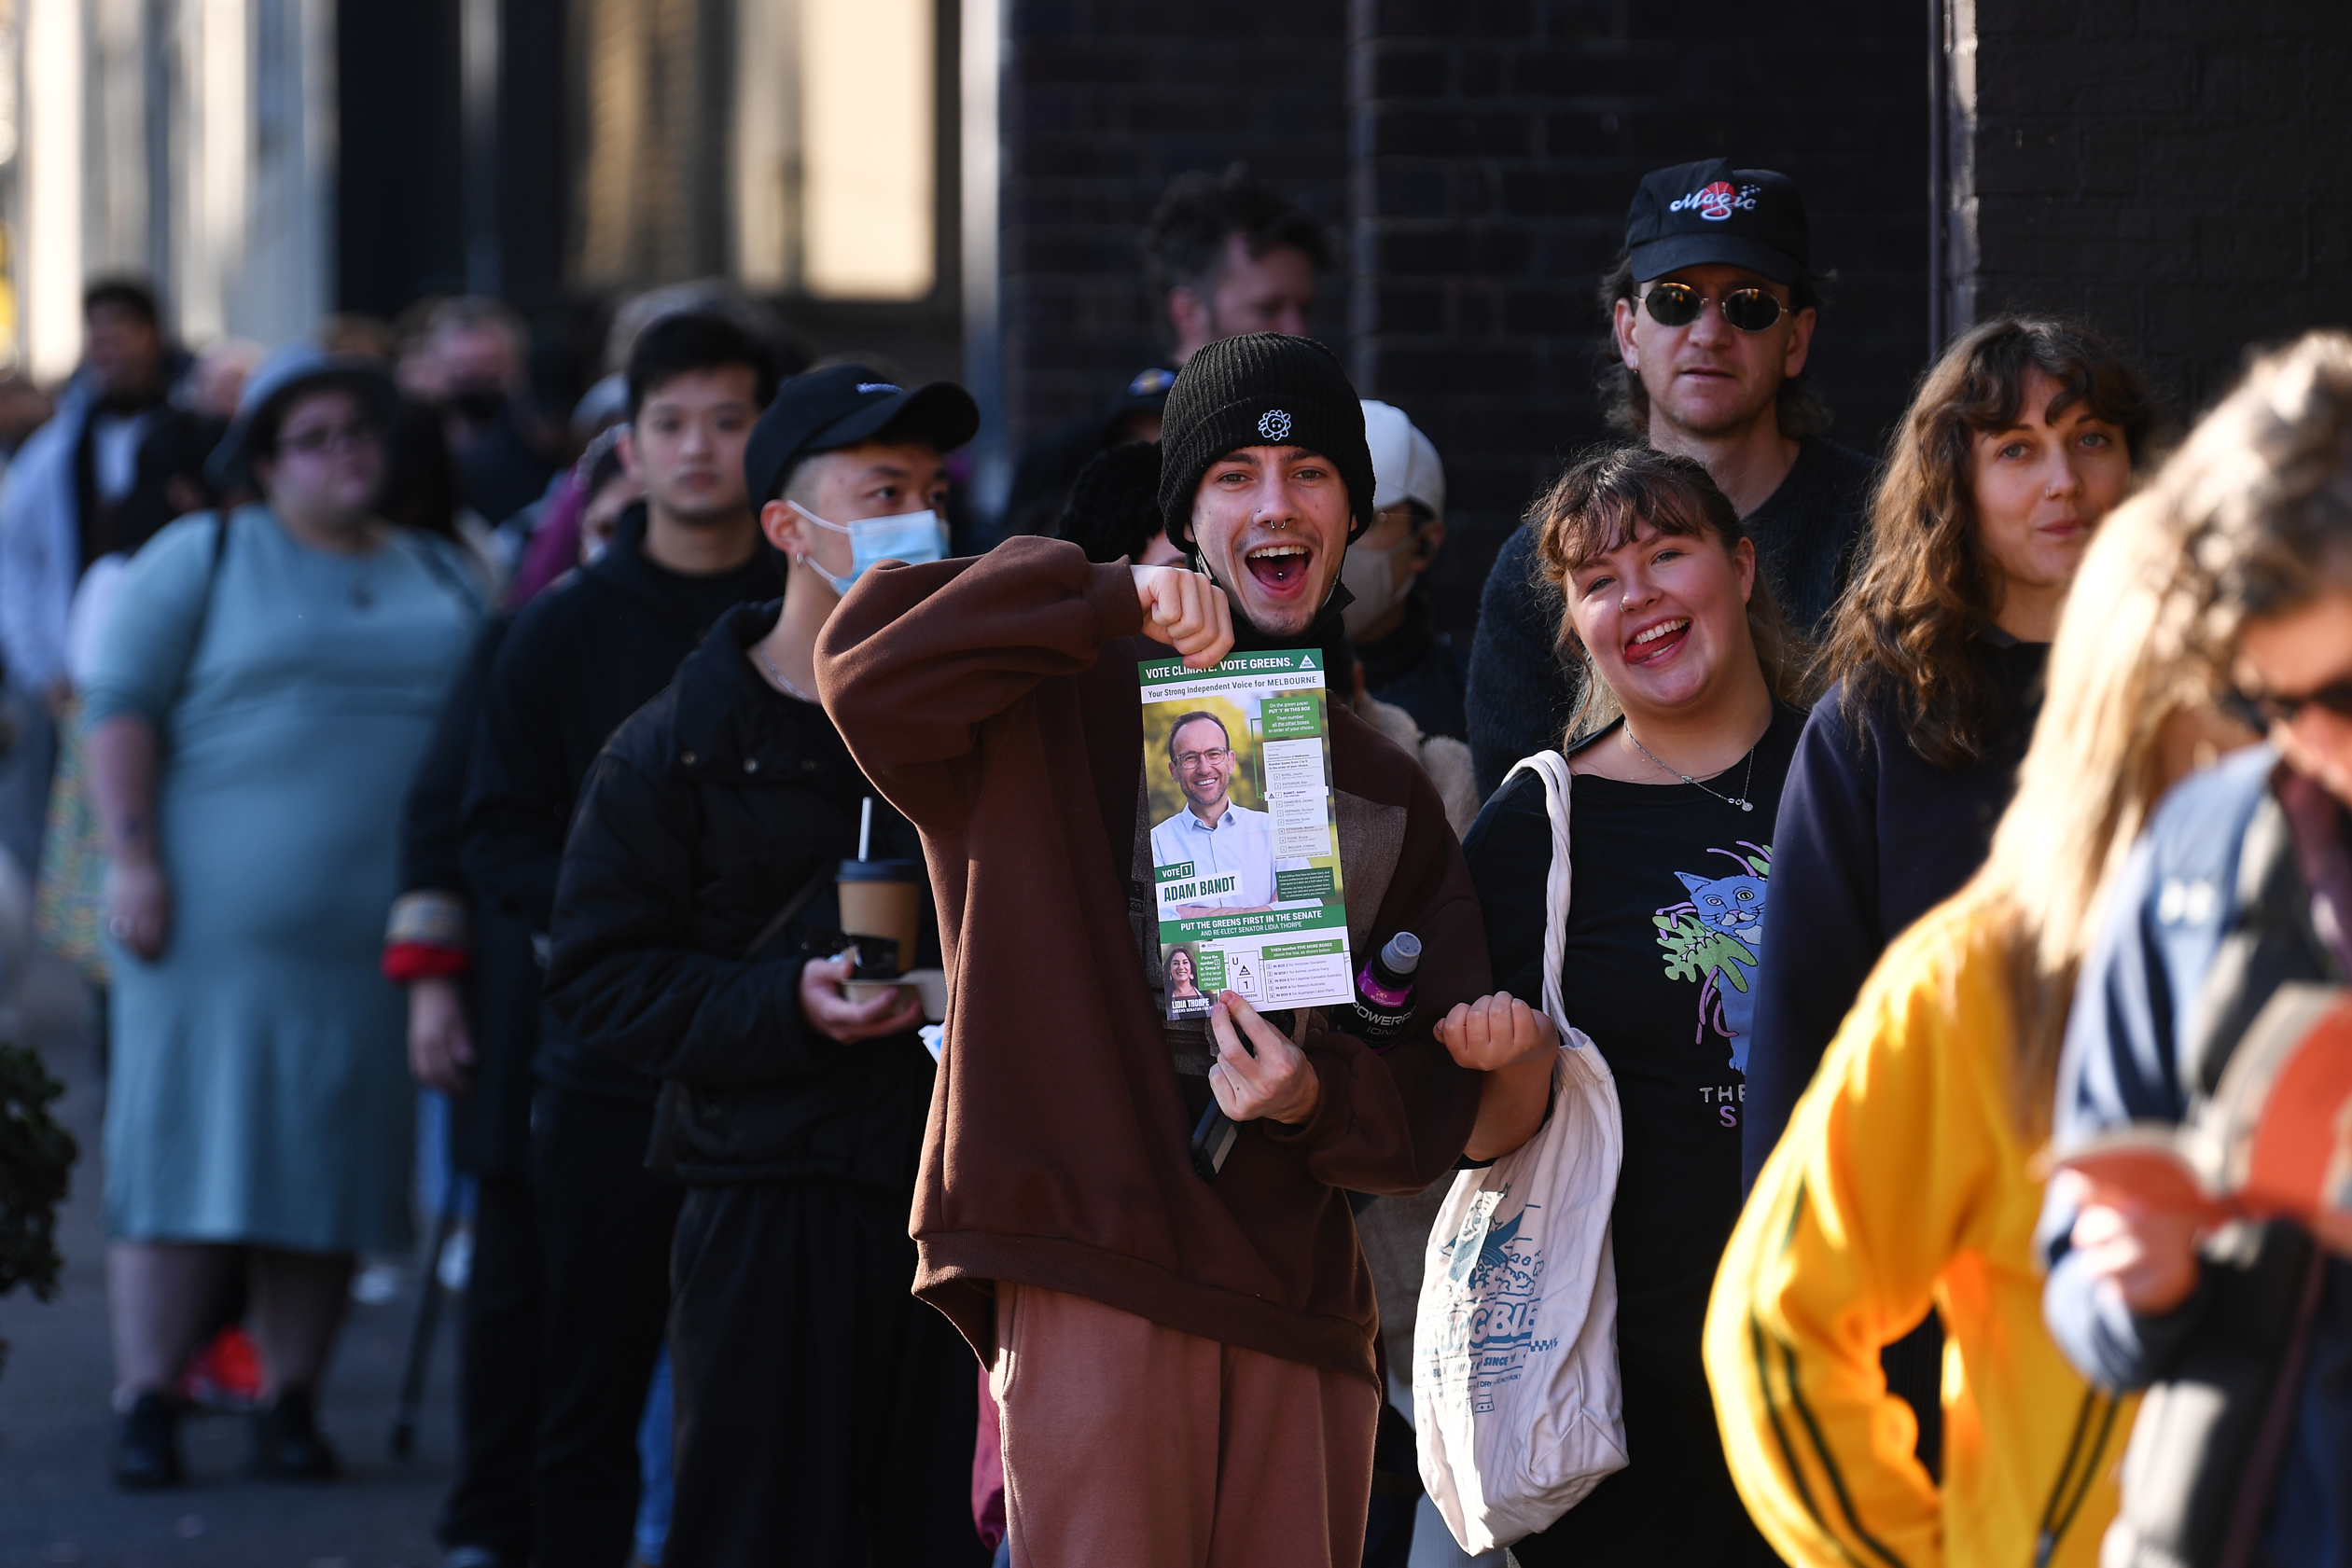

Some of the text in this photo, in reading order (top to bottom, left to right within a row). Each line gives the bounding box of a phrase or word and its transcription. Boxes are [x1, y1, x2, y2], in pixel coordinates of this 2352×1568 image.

[1669, 188, 1756, 221] Magic
[1146, 667, 1170, 679] VOTE
[1220, 660, 1247, 671] VOTE
[1250, 657, 1293, 669] GREENS.
[1165, 688, 1185, 696] Strong
[1188, 683, 1230, 693] Independent
[1268, 676, 1316, 686] MELBOURNE
[1162, 868, 1180, 877] VOTE
[1164, 876, 1235, 902] ADAM BANDT
[1181, 910, 1322, 931] PUT THE GREENS FIRST IN THE SENATE
[1172, 998, 1210, 1009] LIDIA THORPE
[1484, 1356, 1509, 1366] SINCE
